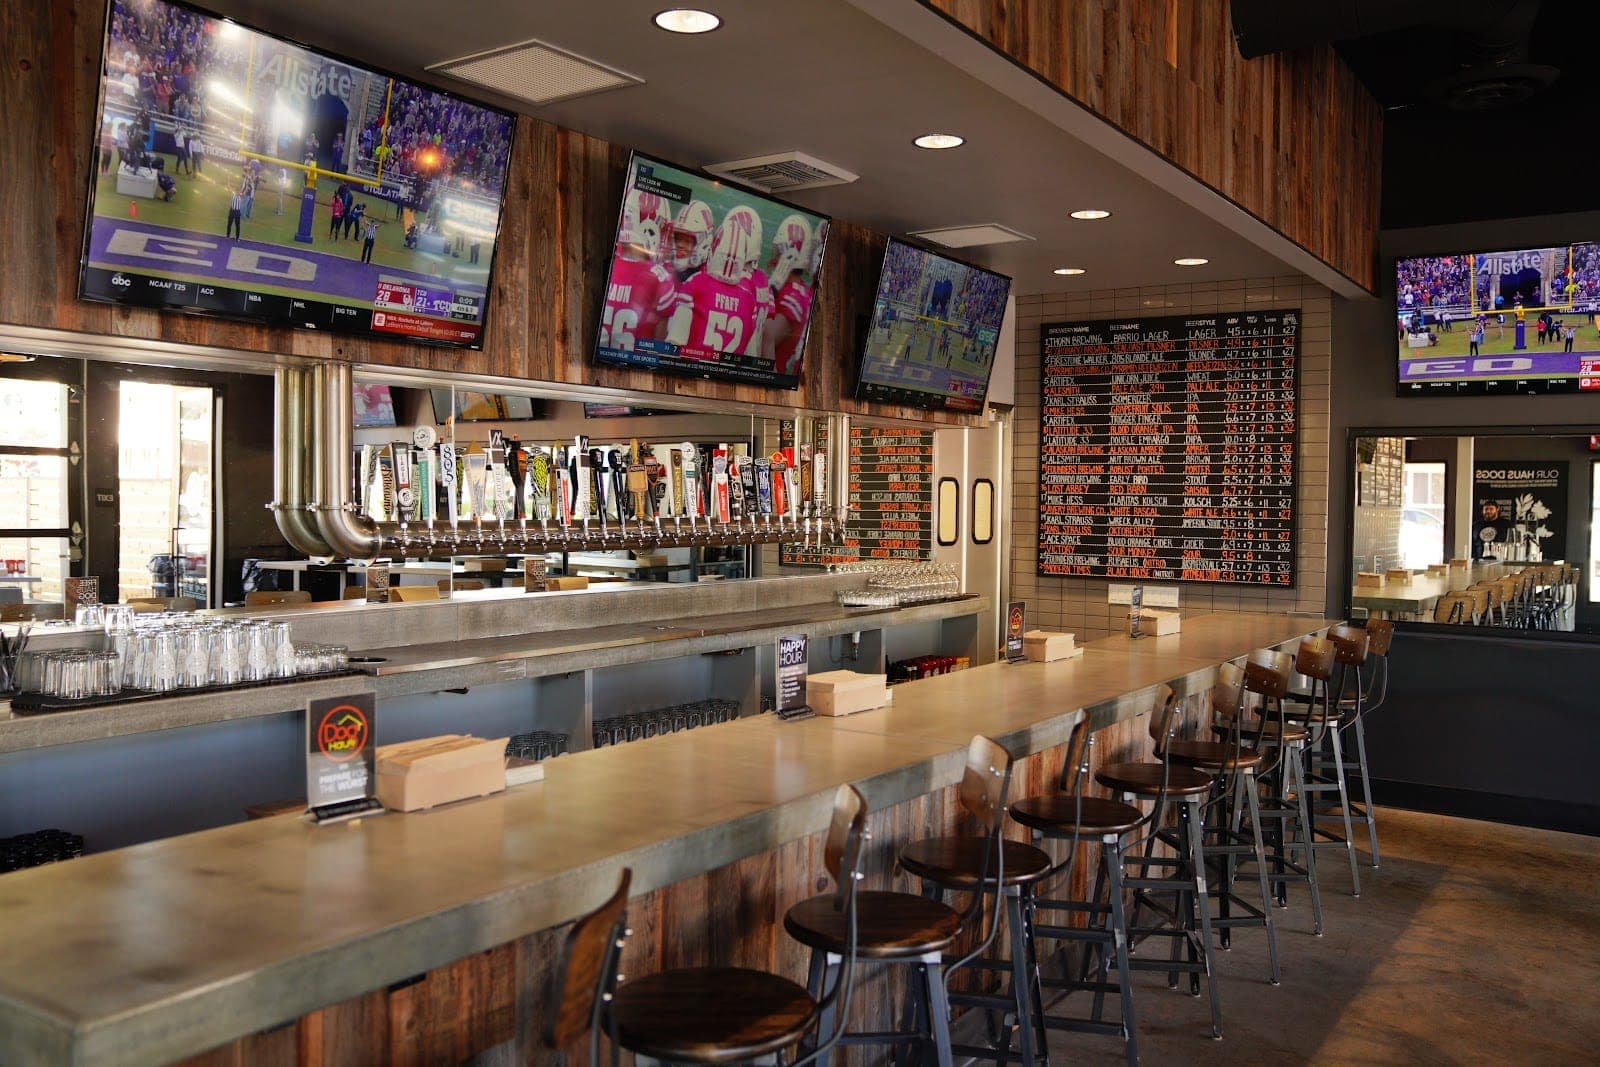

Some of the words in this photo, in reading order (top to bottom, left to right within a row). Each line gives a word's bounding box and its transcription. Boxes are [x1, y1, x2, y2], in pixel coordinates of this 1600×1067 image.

[258, 52, 353, 101] Allstate
[1477, 252, 1541, 275] Allstate
[112, 275, 131, 287] abc
[149, 280, 172, 290] NCAAF
[174, 283, 186, 291] T25
[200, 287, 215, 296] ACC
[382, 283, 411, 294] OKLAHOMA
[376, 290, 391, 301] 28
[294, 301, 306, 309] NHL
[416, 297, 427, 307] 21
[715, 292, 740, 311] PFAFF
[335, 307, 345, 315] BIG
[703, 311, 743, 353] 52
[1189, 328, 1216, 339] LAGER
[1188, 393, 1200, 402] IPA
[1188, 403, 1200, 412] IPA
[1187, 414, 1198, 424] IPA
[1187, 424, 1198, 434] IPA
[1186, 476, 1208, 485] STOUT
[780, 639, 806, 654] HAPPY
[780, 651, 803, 665] HOUR
